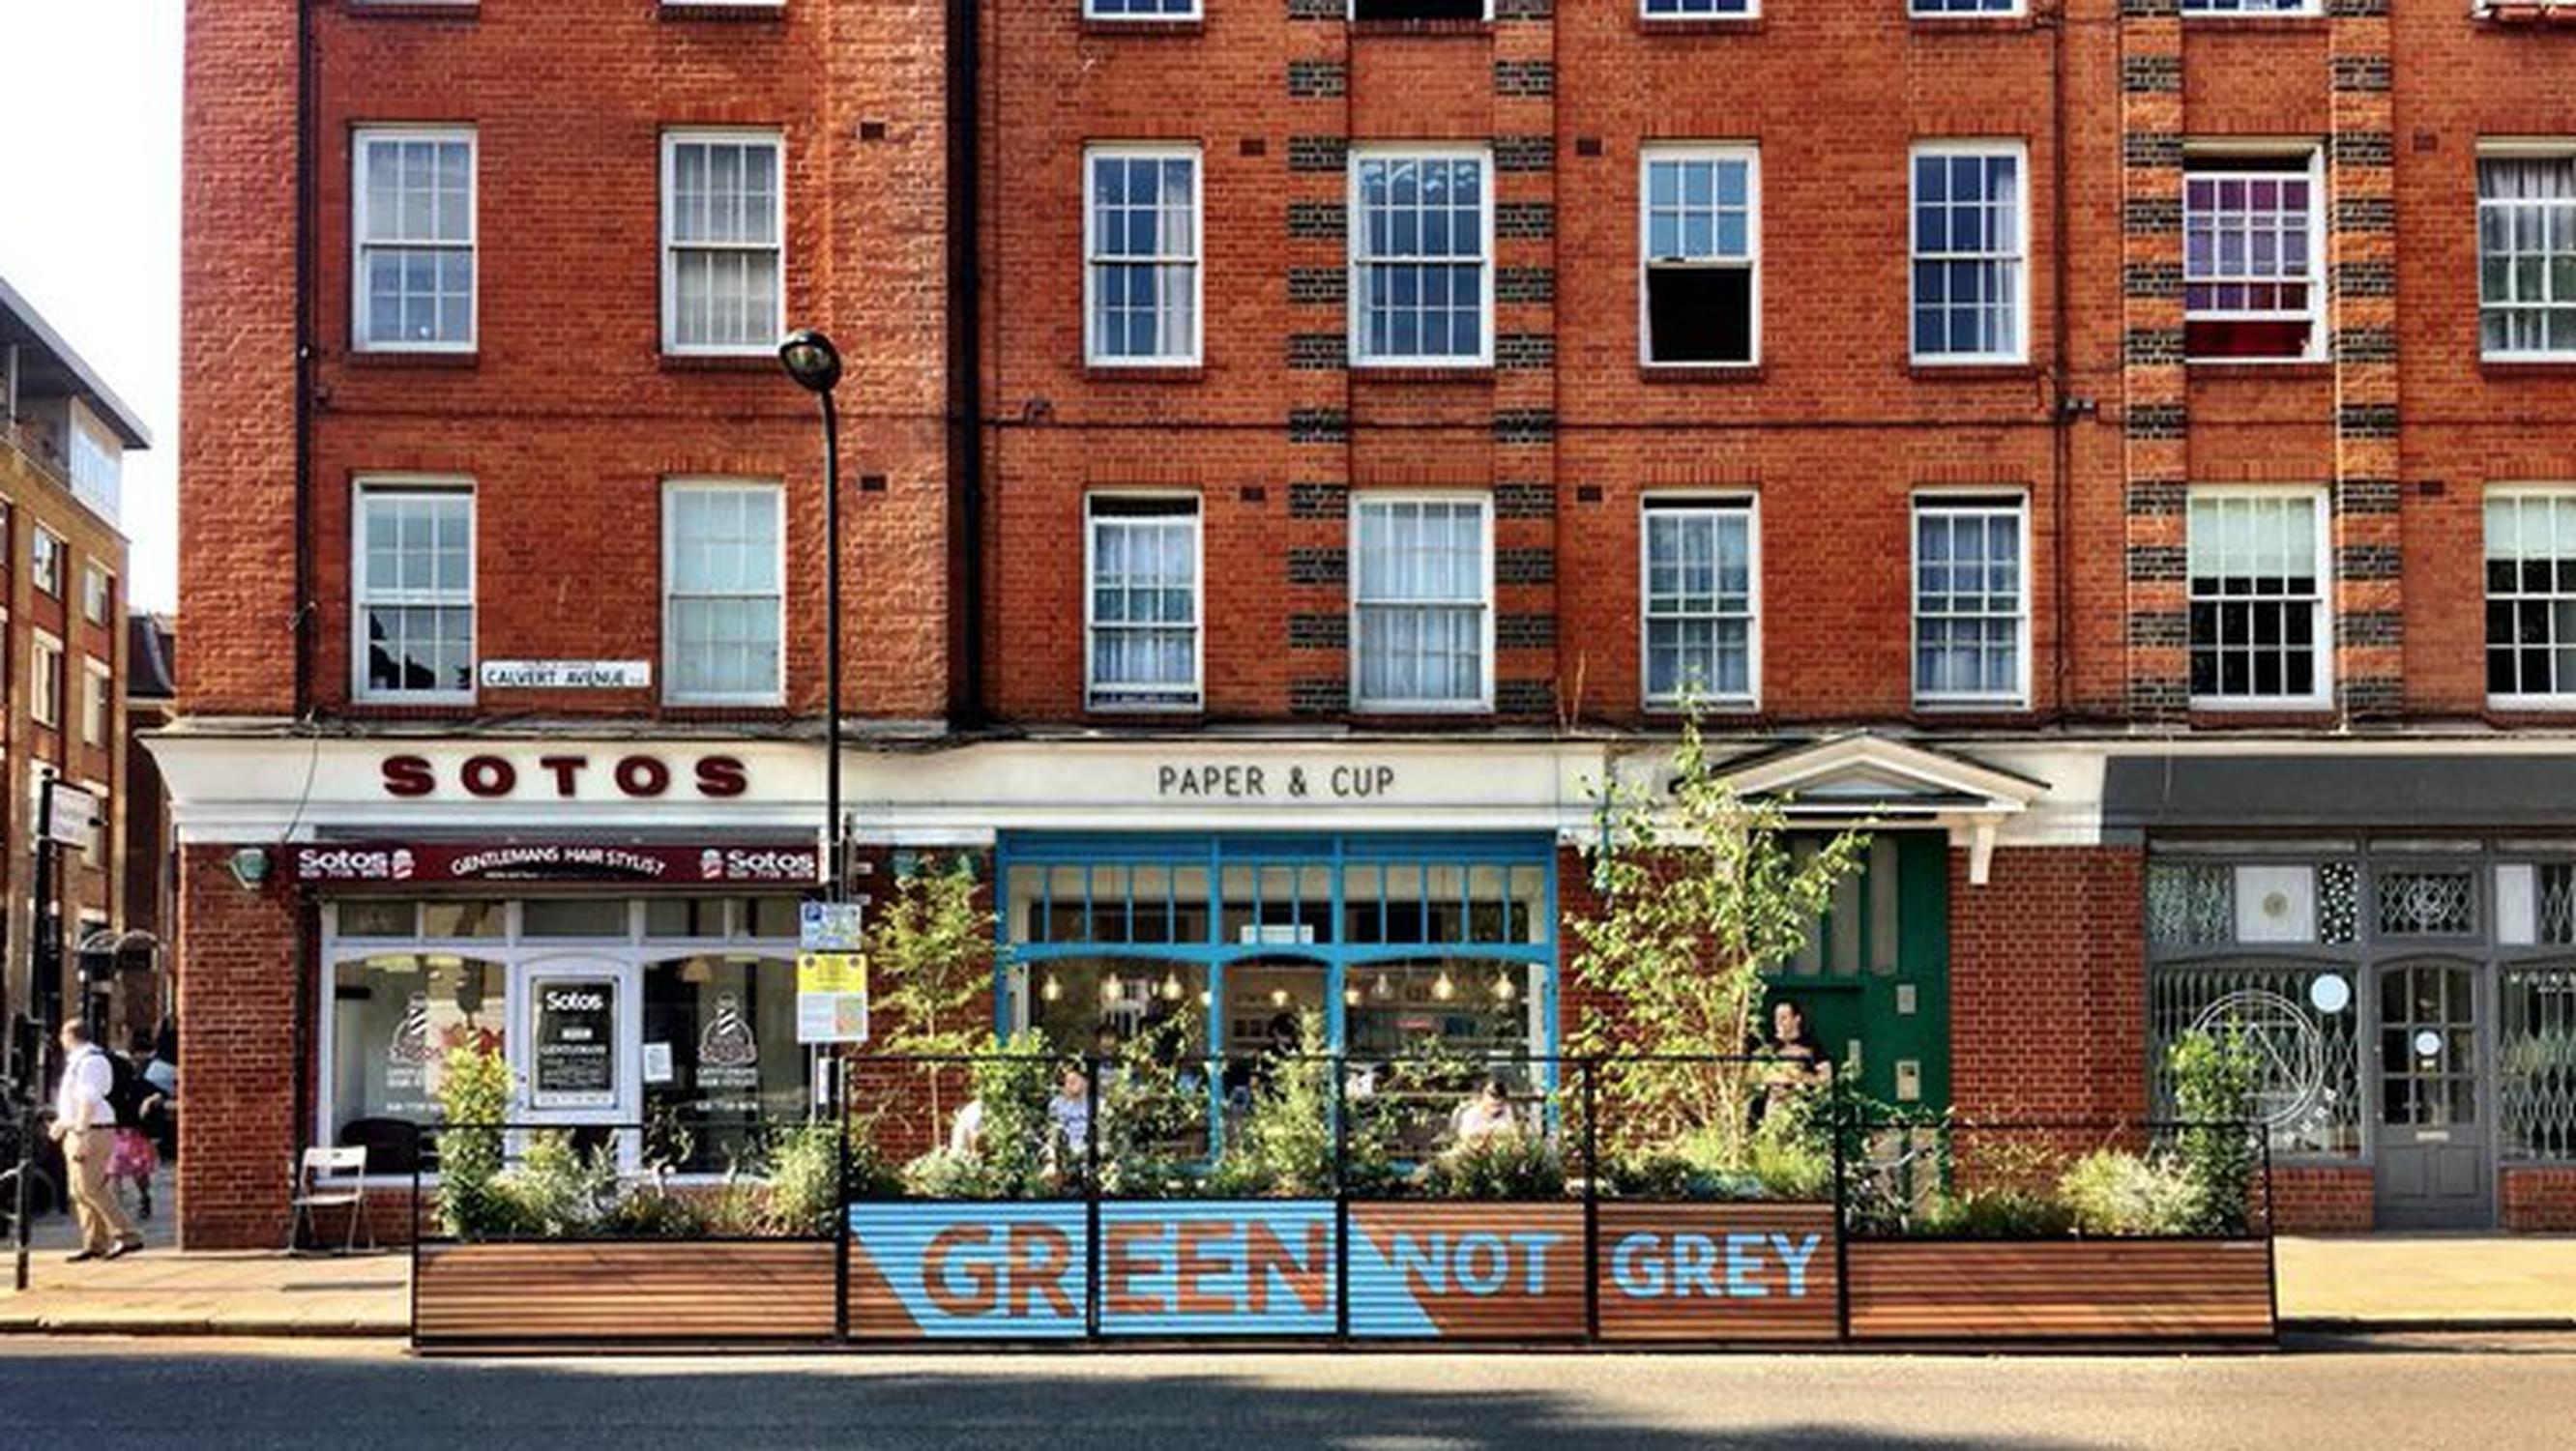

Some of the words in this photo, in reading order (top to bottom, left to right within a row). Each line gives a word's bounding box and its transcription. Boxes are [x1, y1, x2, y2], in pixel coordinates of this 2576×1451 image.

[486, 670, 557, 684] CALVERT
[566, 670, 625, 685] AVENUE
[382, 755, 747, 798] SOTOS
[1158, 765, 1265, 796] PAPER
[1288, 766, 1307, 797] &
[1331, 765, 1394, 797] CUP
[299, 850, 387, 869] Sotos
[451, 846, 560, 875] GENTLEMANS
[564, 848, 603, 863] HAIR
[606, 850, 665, 875] STYLIST
[727, 850, 814, 870] Sotos
[546, 991, 603, 1010] Sotos
[922, 1220, 1328, 1319] GREEN
[1389, 1233, 1565, 1294] NOT
[1613, 1232, 1823, 1297] GREY
